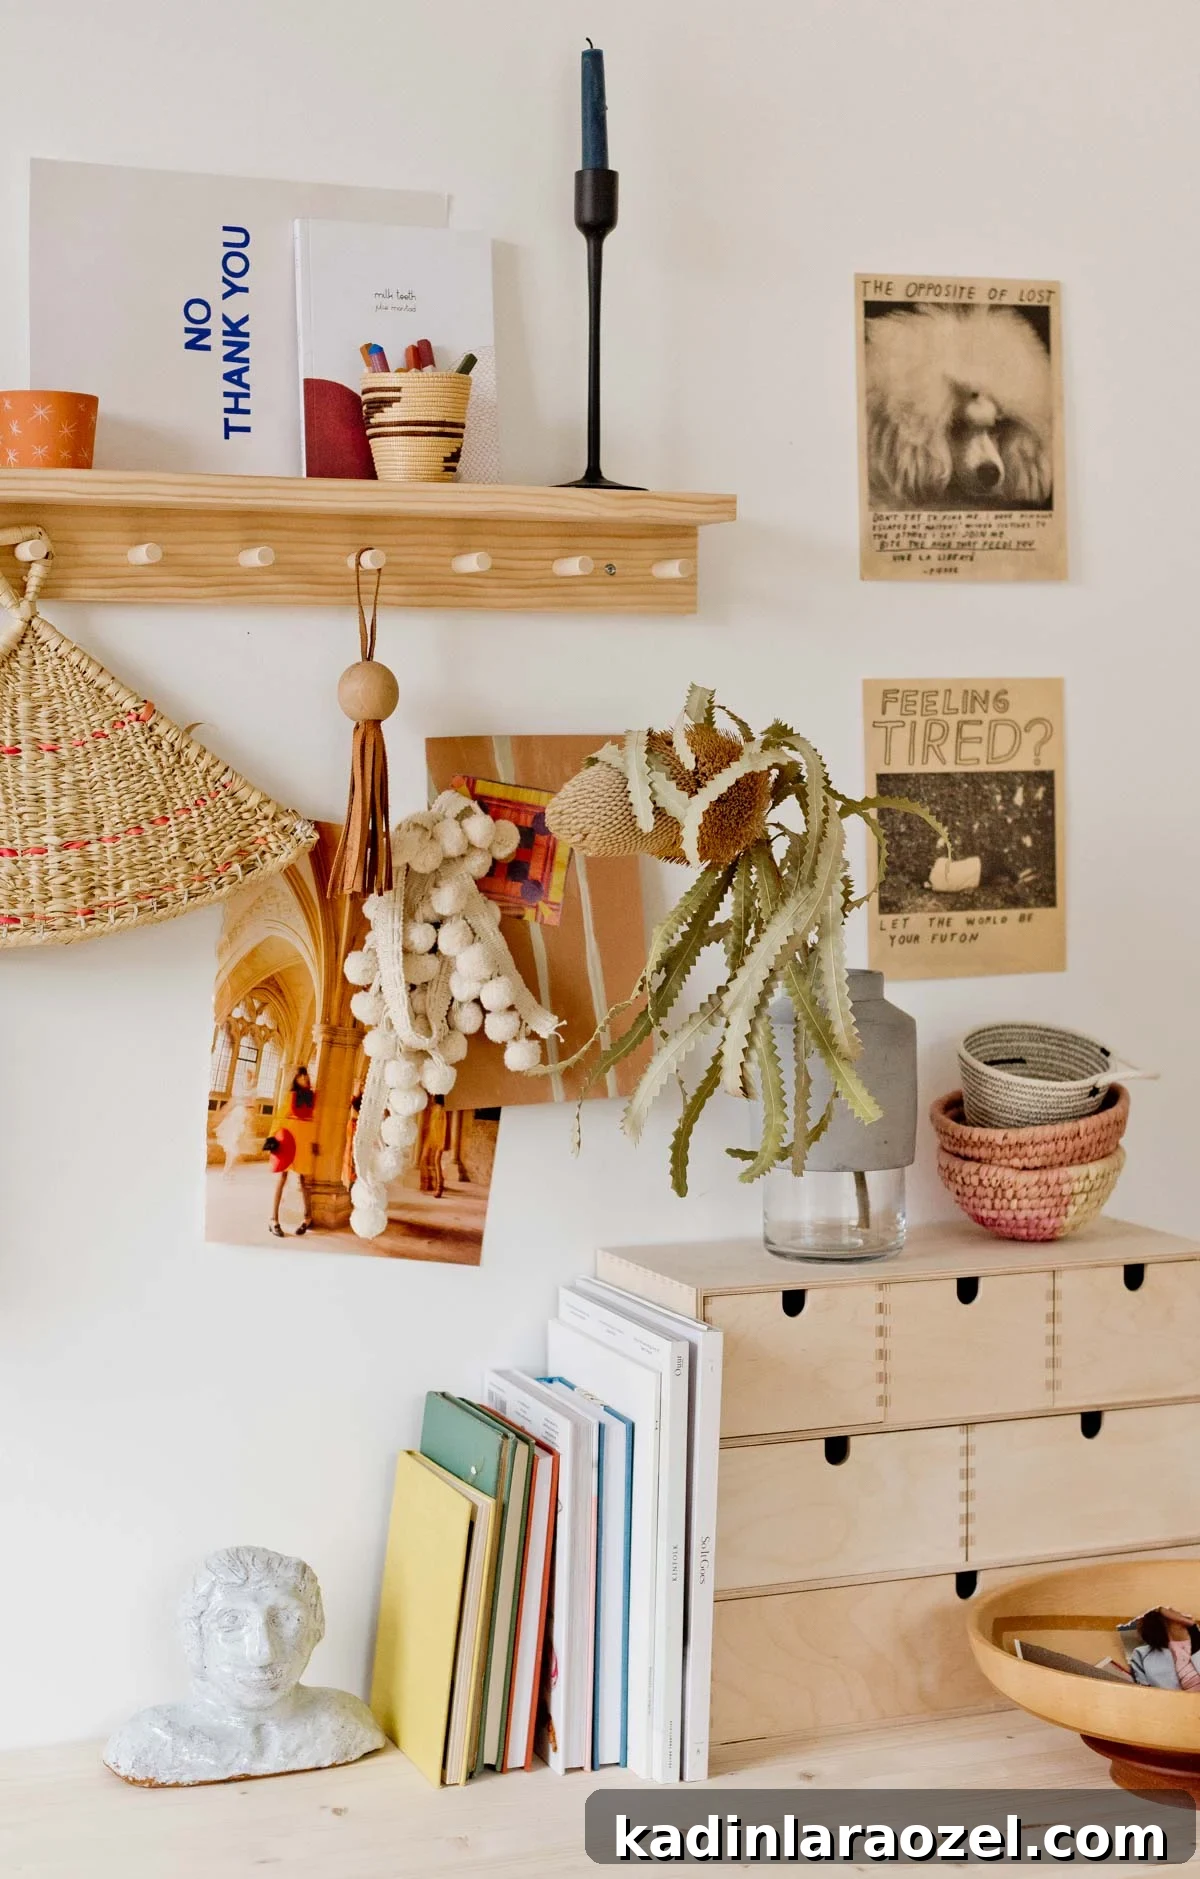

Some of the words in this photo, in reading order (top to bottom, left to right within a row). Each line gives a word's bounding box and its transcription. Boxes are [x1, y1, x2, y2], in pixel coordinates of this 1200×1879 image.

[221, 225, 251, 301] YOU
[374, 288, 393, 299] milk
[396, 288, 417, 301] teeth
[861, 280, 893, 297] THE
[905, 282, 975, 299] OPPOSITE
[988, 288, 1008, 300] OF
[1019, 289, 1056, 303] LOST
[183, 298, 212, 351] NO
[221, 312, 251, 440] THANK
[881, 688, 1010, 716] FEELING
[872, 717, 1054, 766] TIRED?
[879, 917, 910, 931] LET
[928, 916, 953, 928] THE
[966, 915, 1008, 926] WORLD
[1018, 913, 1034, 923] BE
[889, 933, 920, 947] YOUR
[931, 932, 979, 944] FUTON
[700, 1559, 710, 1584] Goes
